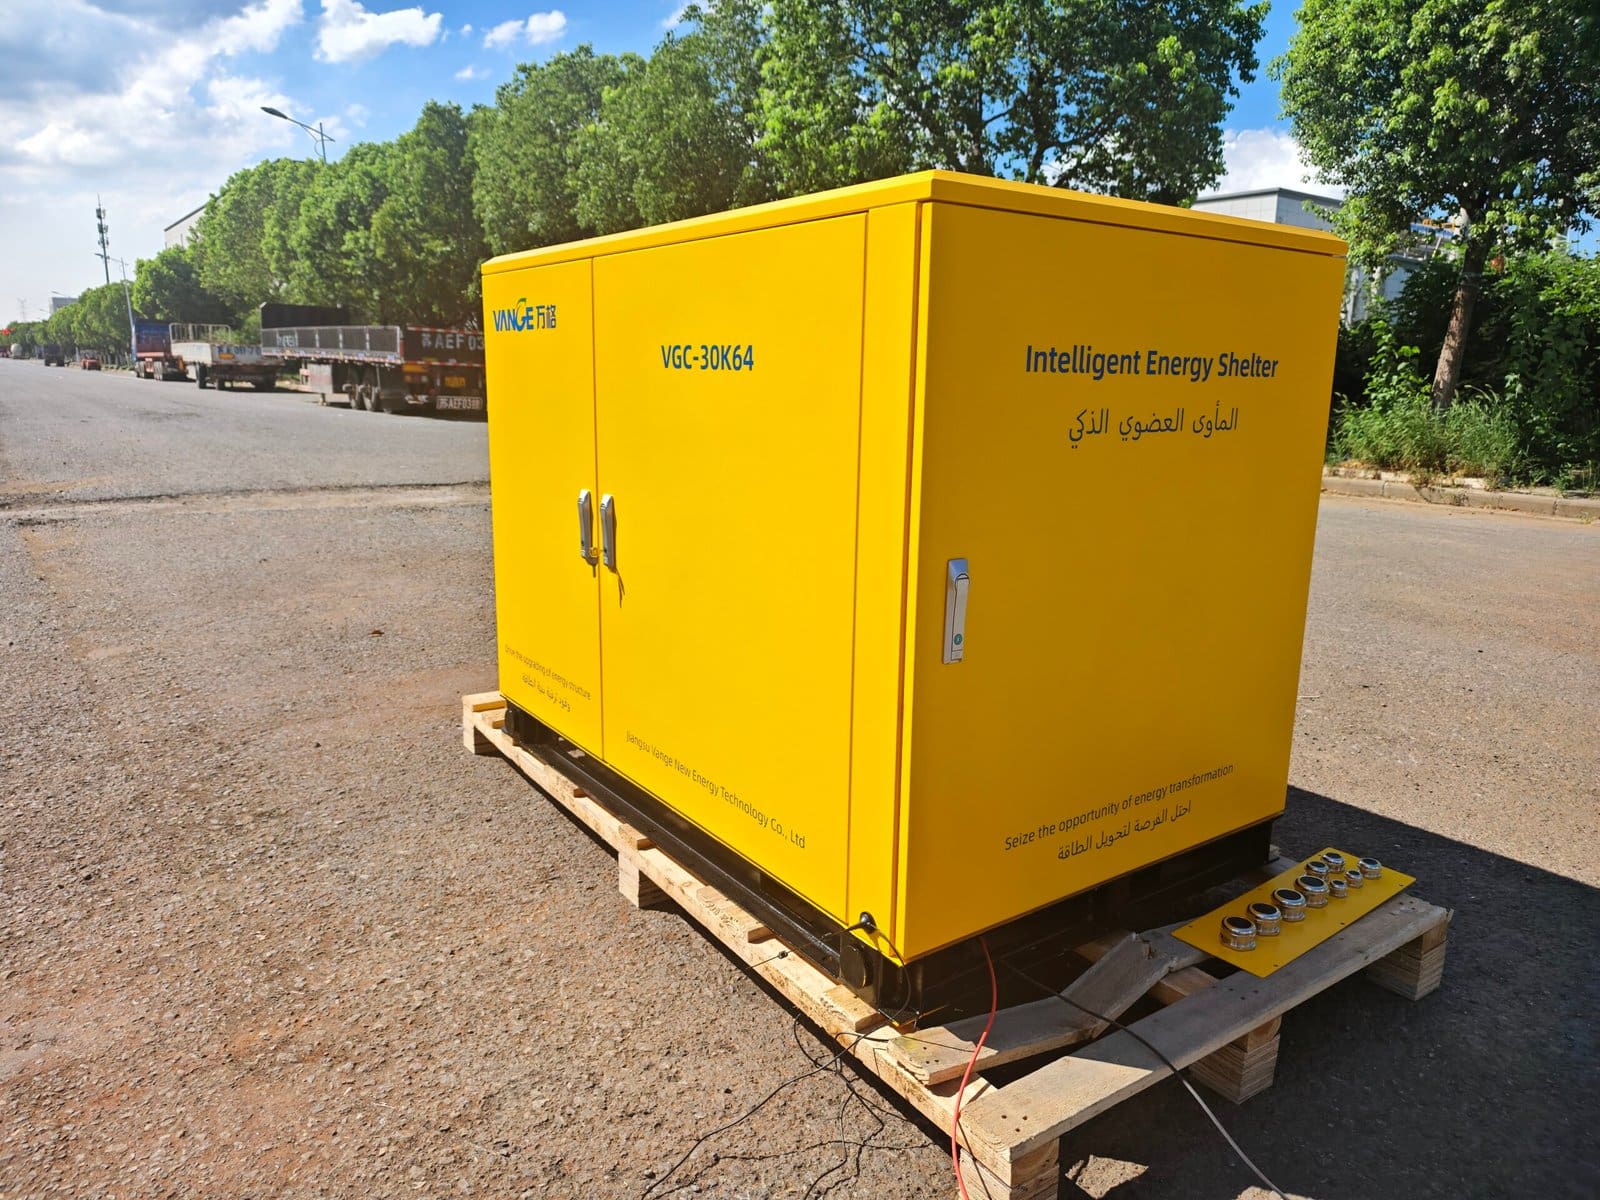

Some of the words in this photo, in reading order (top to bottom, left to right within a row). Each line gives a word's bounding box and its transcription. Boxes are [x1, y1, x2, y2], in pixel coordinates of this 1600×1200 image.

[492, 298, 534, 332] VANGE
[536, 304, 557, 330] 万格
[661, 344, 755, 371] VGC-30K64
[1025, 345, 1142, 381] Intelligent
[1146, 350, 1214, 383] Energy
[1217, 351, 1279, 378] Shelter
[1069, 408, 1109, 449] الذكي
[1119, 407, 1185, 442] العضوي
[1192, 400, 1239, 438] المأوى
[626, 729, 650, 753] Jiangsu
[651, 744, 673, 767] Vange
[674, 759, 692, 778] New
[692, 769, 720, 796] Energy
[720, 786, 769, 829] Technology
[790, 829, 806, 849] Ltd
[1005, 829, 1035, 851] Seize
[1038, 822, 1056, 838] the
[1058, 801, 1120, 832] opportunity
[1122, 794, 1133, 810] of
[1134, 784, 1168, 807] energy
[1169, 763, 1234, 794] transformation
